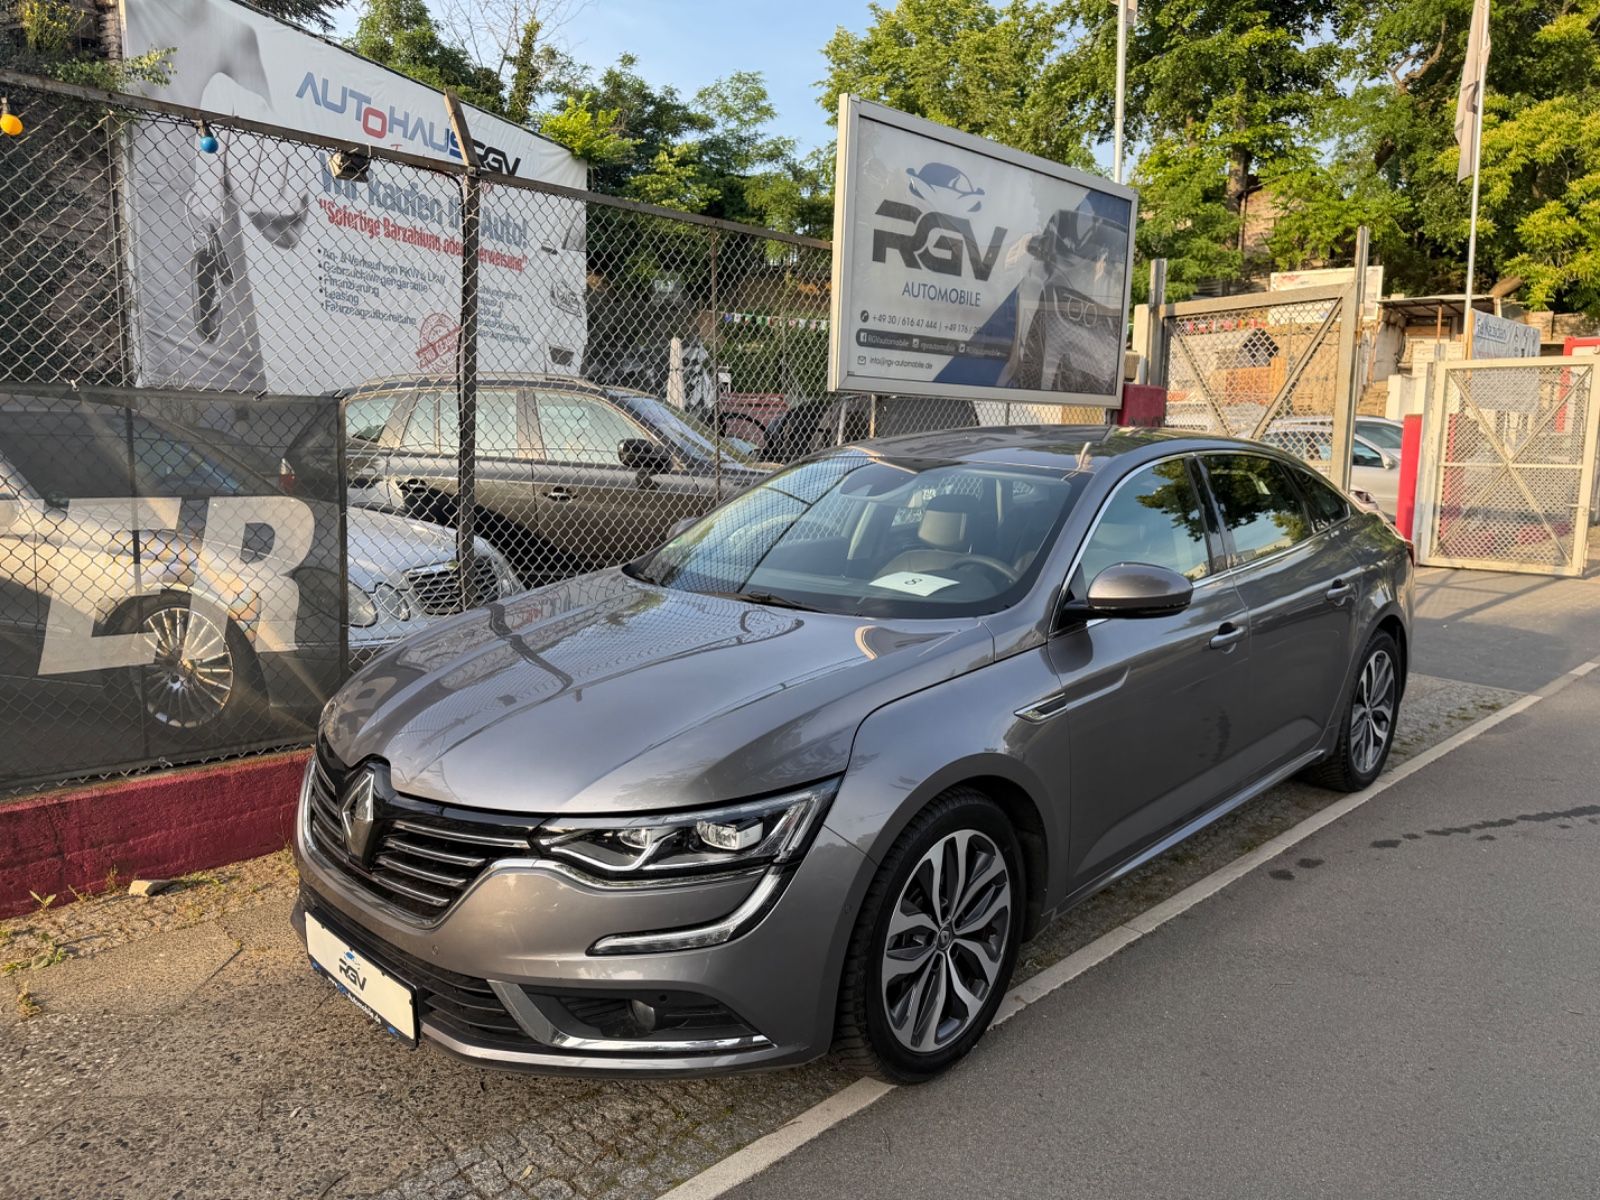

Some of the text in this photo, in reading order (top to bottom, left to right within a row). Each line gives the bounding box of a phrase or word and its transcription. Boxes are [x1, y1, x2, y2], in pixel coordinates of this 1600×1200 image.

[367, 169, 443, 225] kaufen
[480, 206, 528, 249] Auto!
[383, 216, 441, 253] Barzahlung
[443, 236, 464, 257] ode
[872, 199, 1008, 282] RGV
[324, 287, 359, 306] Leasing
[902, 281, 981, 307] AUTOMOBILE
[872, 313, 887, 323] +49
[888, 315, 897, 325] 30
[902, 316, 915, 327] 616
[0, 496, 316, 676] ER
[339, 957, 367, 991] RGV
